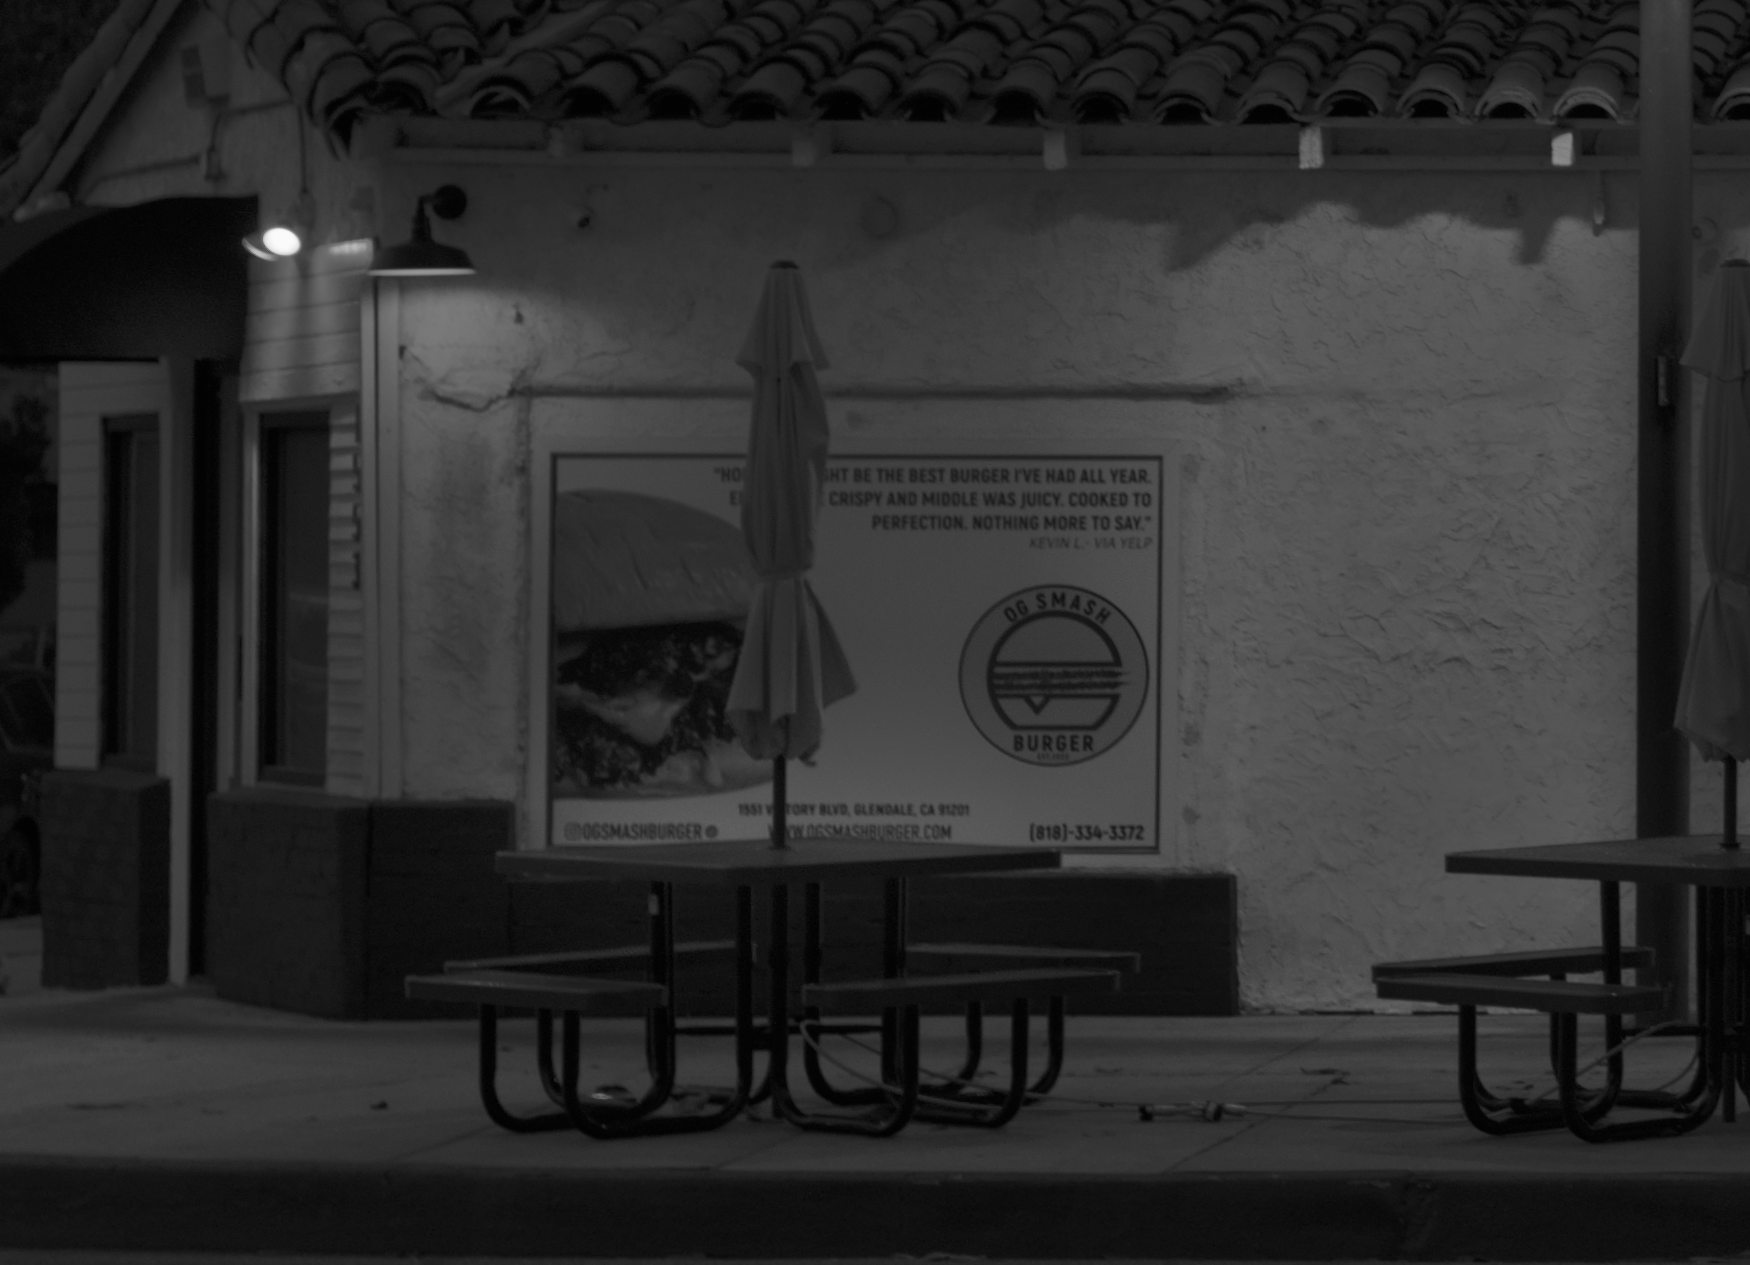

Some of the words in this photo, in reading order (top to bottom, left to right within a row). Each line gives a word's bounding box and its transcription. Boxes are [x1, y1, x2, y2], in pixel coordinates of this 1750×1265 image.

[853, 467, 872, 484] BE
[877, 467, 904, 484] THE
[909, 467, 946, 484] BEST
[951, 467, 1010, 484] BURGER
[1014, 467, 1041, 484] I'VE
[1046, 467, 1076, 484] HAD
[1079, 467, 1106, 484] ALL
[1110, 467, 1151, 484] YEAR.
[828, 490, 882, 507] CRISPY
[886, 490, 918, 507] AND
[922, 490, 978, 507] MIDDLE
[982, 490, 1016, 507] WAS
[1020, 490, 1065, 509] JUICY.
[1068, 490, 1128, 507] COOKED
[1133, 490, 1152, 507] TO
[871, 514, 968, 531] PERFECTION.
[972, 514, 1039, 531] NOTHING
[1043, 514, 1087, 531] MORE
[1091, 514, 1110, 531] TO
[1029, 537, 1070, 550] KEVIN
[1119, 537, 1153, 550] YELP
[1004, 599, 1029, 622] OG
[1035, 592, 1111, 624] SMASH
[1013, 734, 1094, 751] BURGER
[765, 803, 816, 817] VTORY
[919, 803, 936, 817] CA
[563, 821, 703, 841] @OGSMASHBURGER
[1029, 822, 1145, 842] (818)-334-3372
